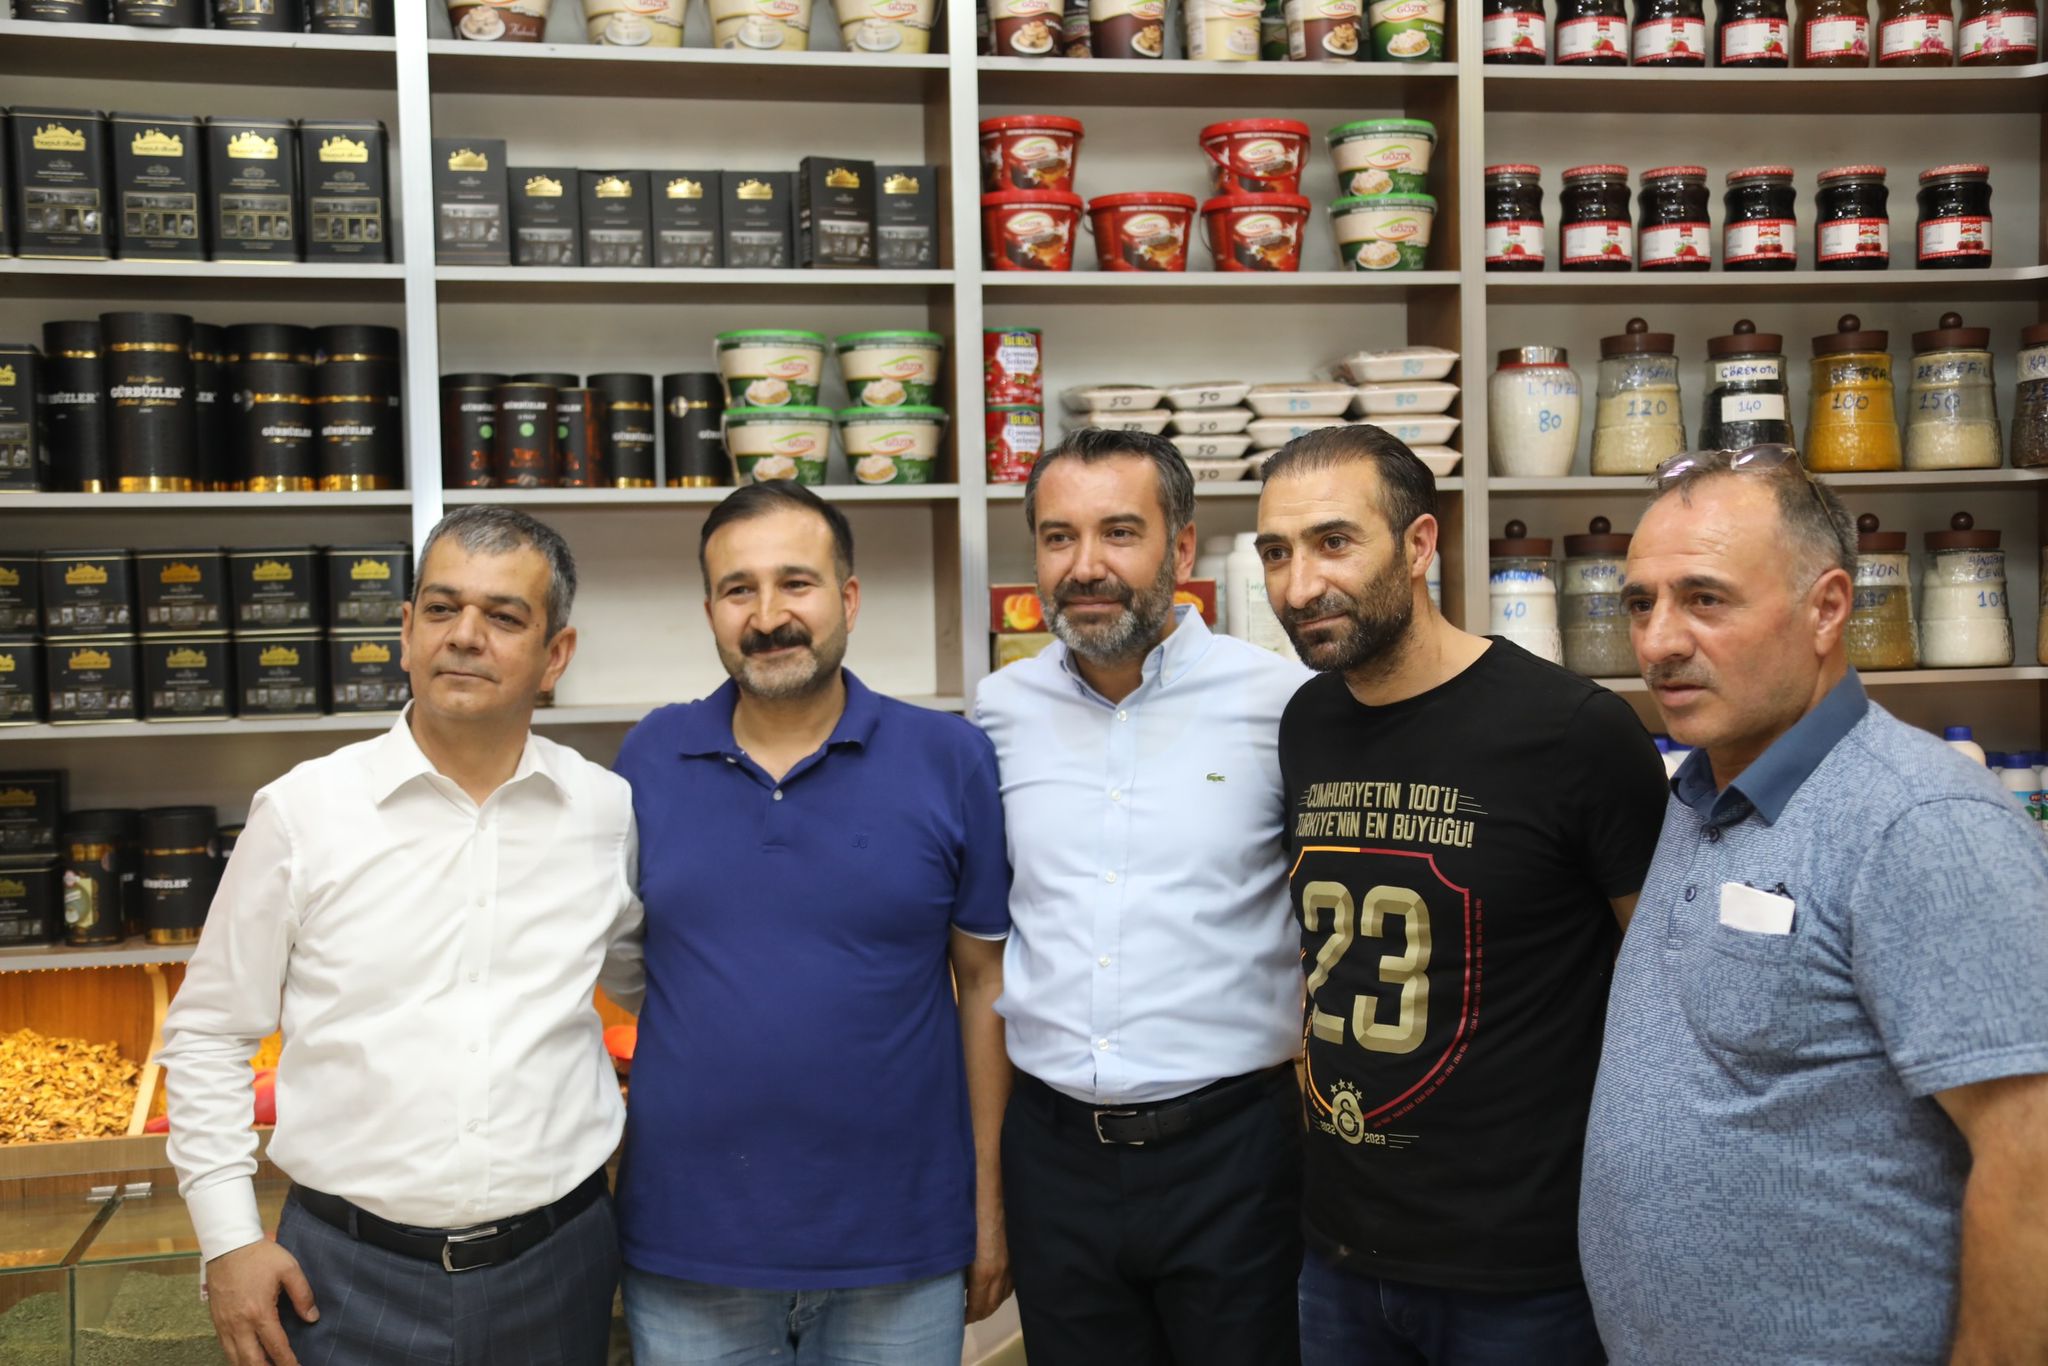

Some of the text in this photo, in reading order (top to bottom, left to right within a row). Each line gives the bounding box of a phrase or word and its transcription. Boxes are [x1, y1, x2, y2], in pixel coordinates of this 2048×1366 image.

[110, 385, 184, 399] GÜRBÜZLER
[1199, 391, 1220, 404] 50
[1110, 396, 1132, 408] 50
[1626, 400, 1668, 416] 120
[1832, 394, 1870, 410] 100
[1919, 392, 1961, 410] 150
[1538, 409, 1562, 432] 80
[1197, 444, 1218, 456] 50
[1198, 468, 1221, 481] 50
[1580, 565, 1617, 580] KARA
[1503, 601, 1526, 621] 40
[1365, 812, 1388, 839] EN
[1392, 813, 1475, 848] BÜYÜĞÜ!
[1302, 880, 1432, 1054] 23
[1364, 1132, 1386, 1145] 2023
